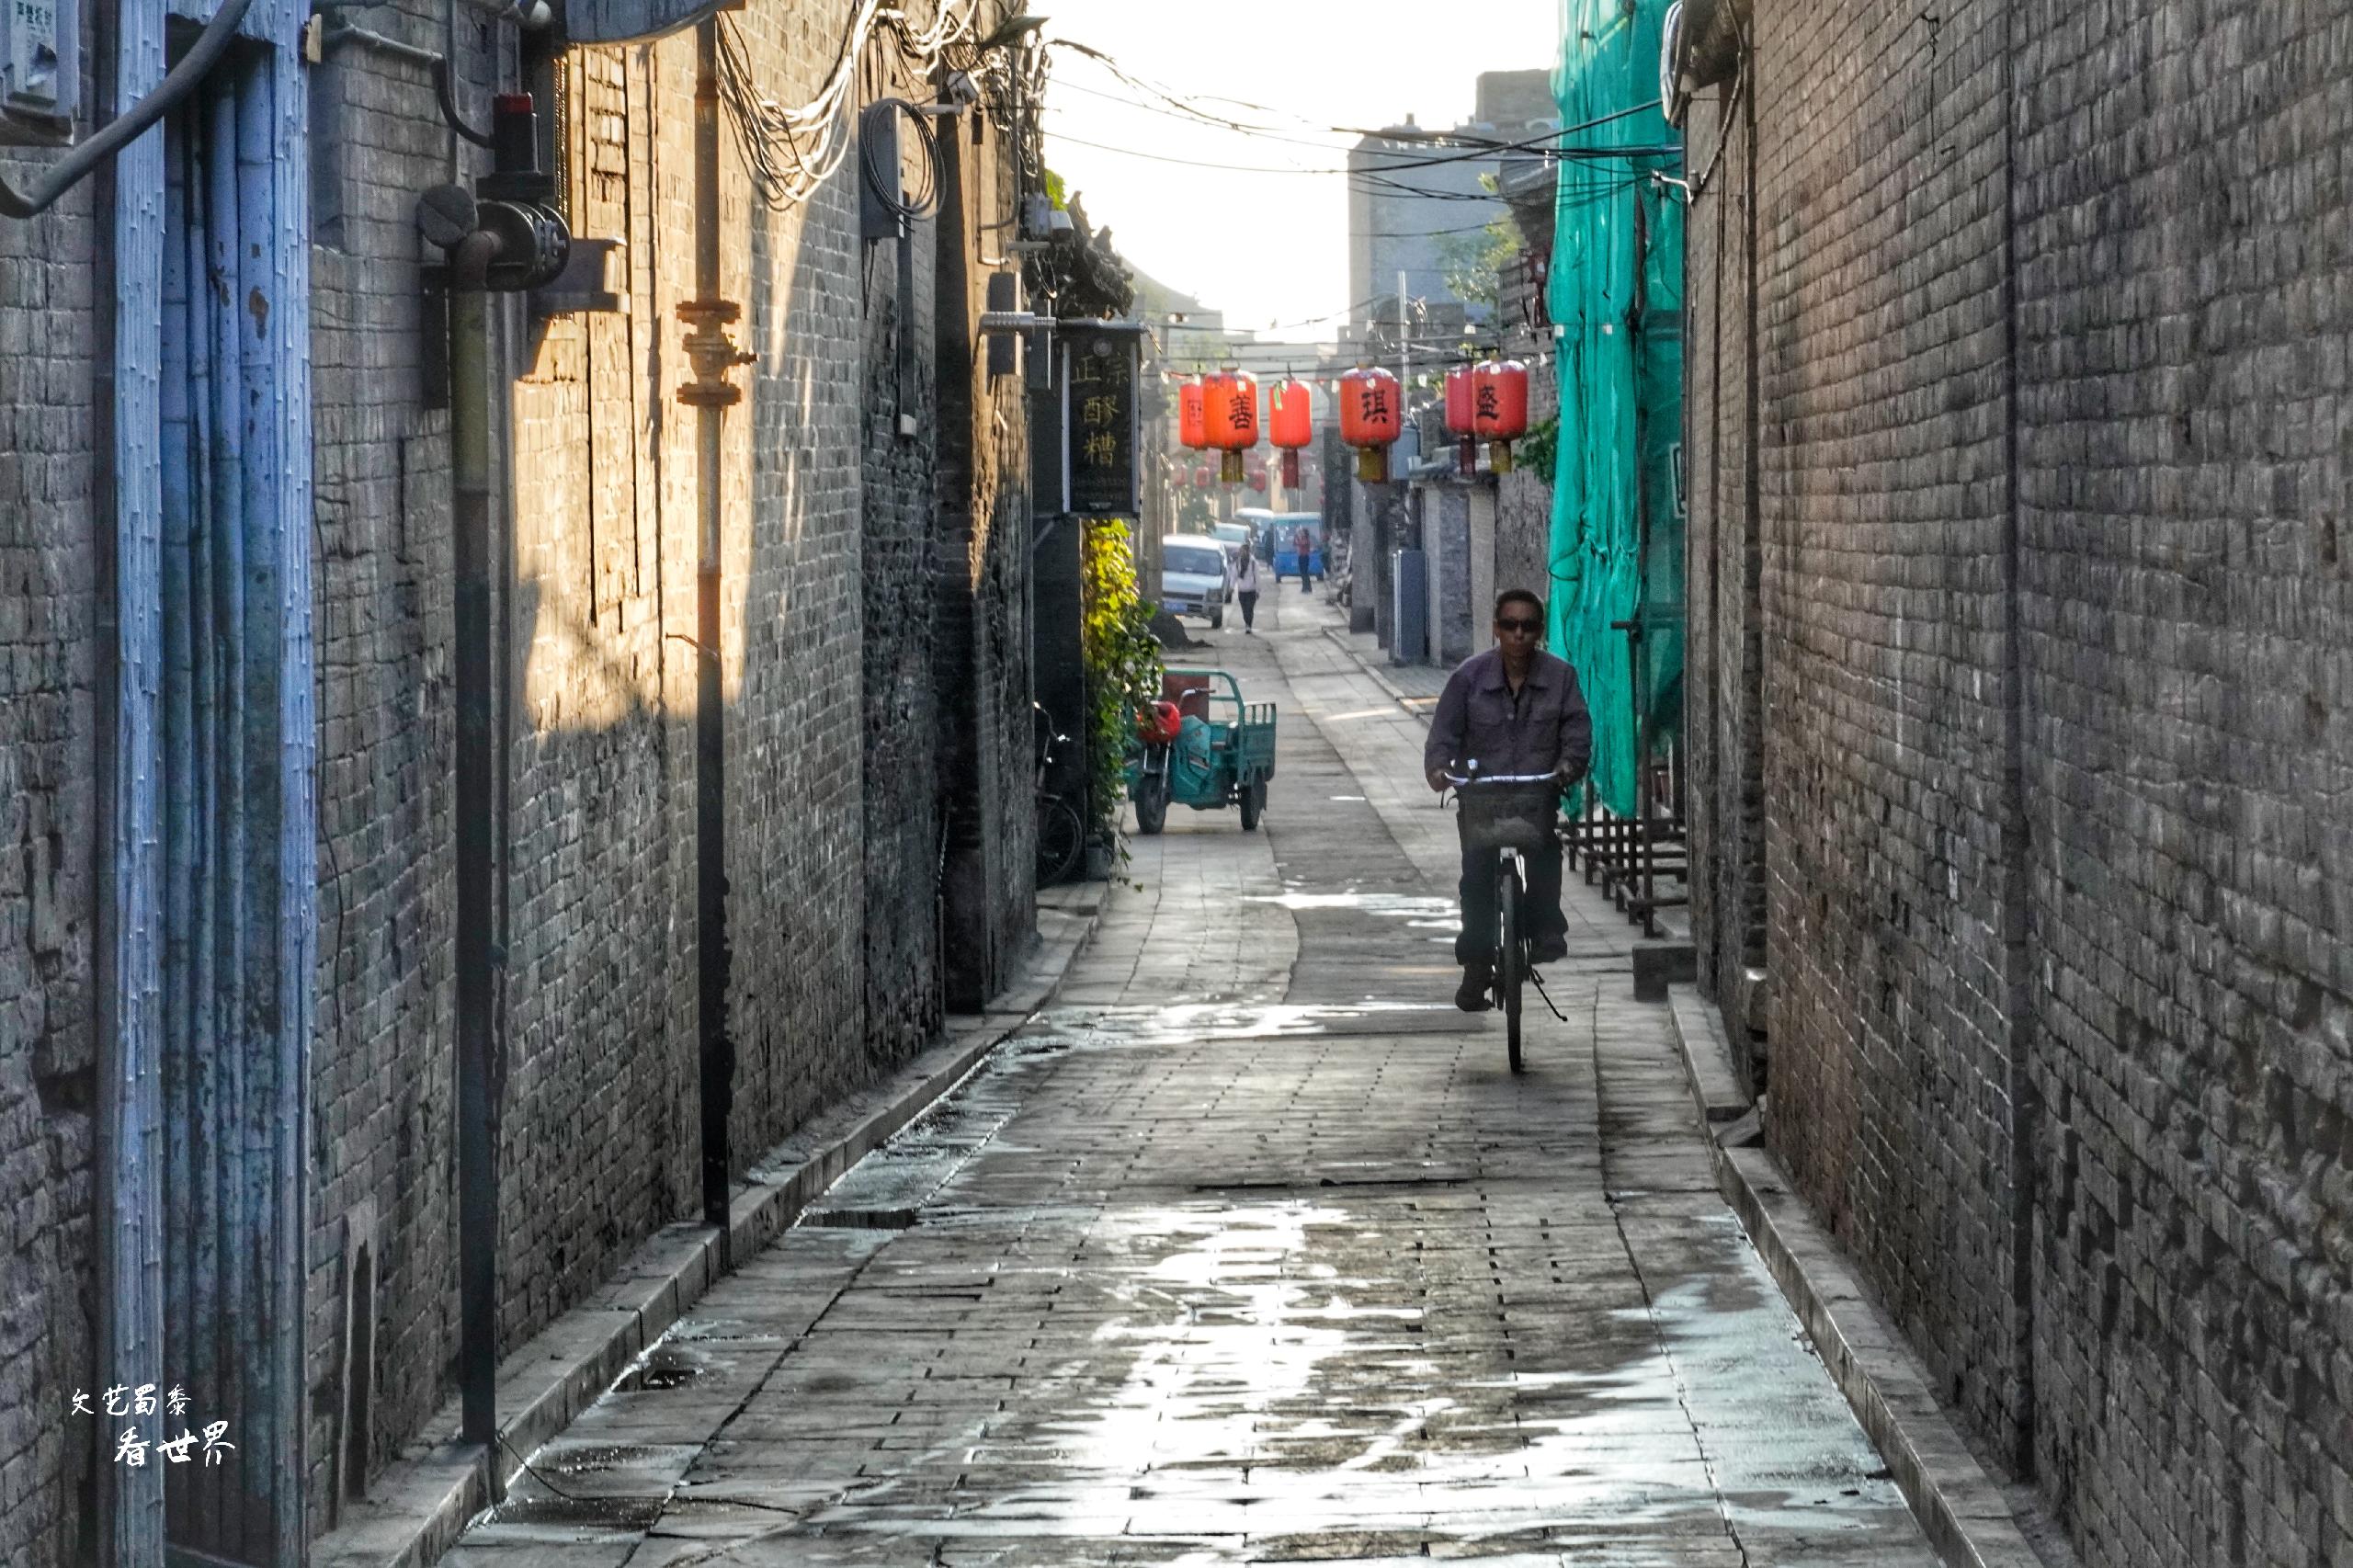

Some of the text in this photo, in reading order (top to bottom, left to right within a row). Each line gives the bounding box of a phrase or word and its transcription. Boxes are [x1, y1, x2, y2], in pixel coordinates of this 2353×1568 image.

[1071, 352, 1130, 384] 正宗
[1229, 394, 1253, 430] 善
[1476, 384, 1498, 420] 盛
